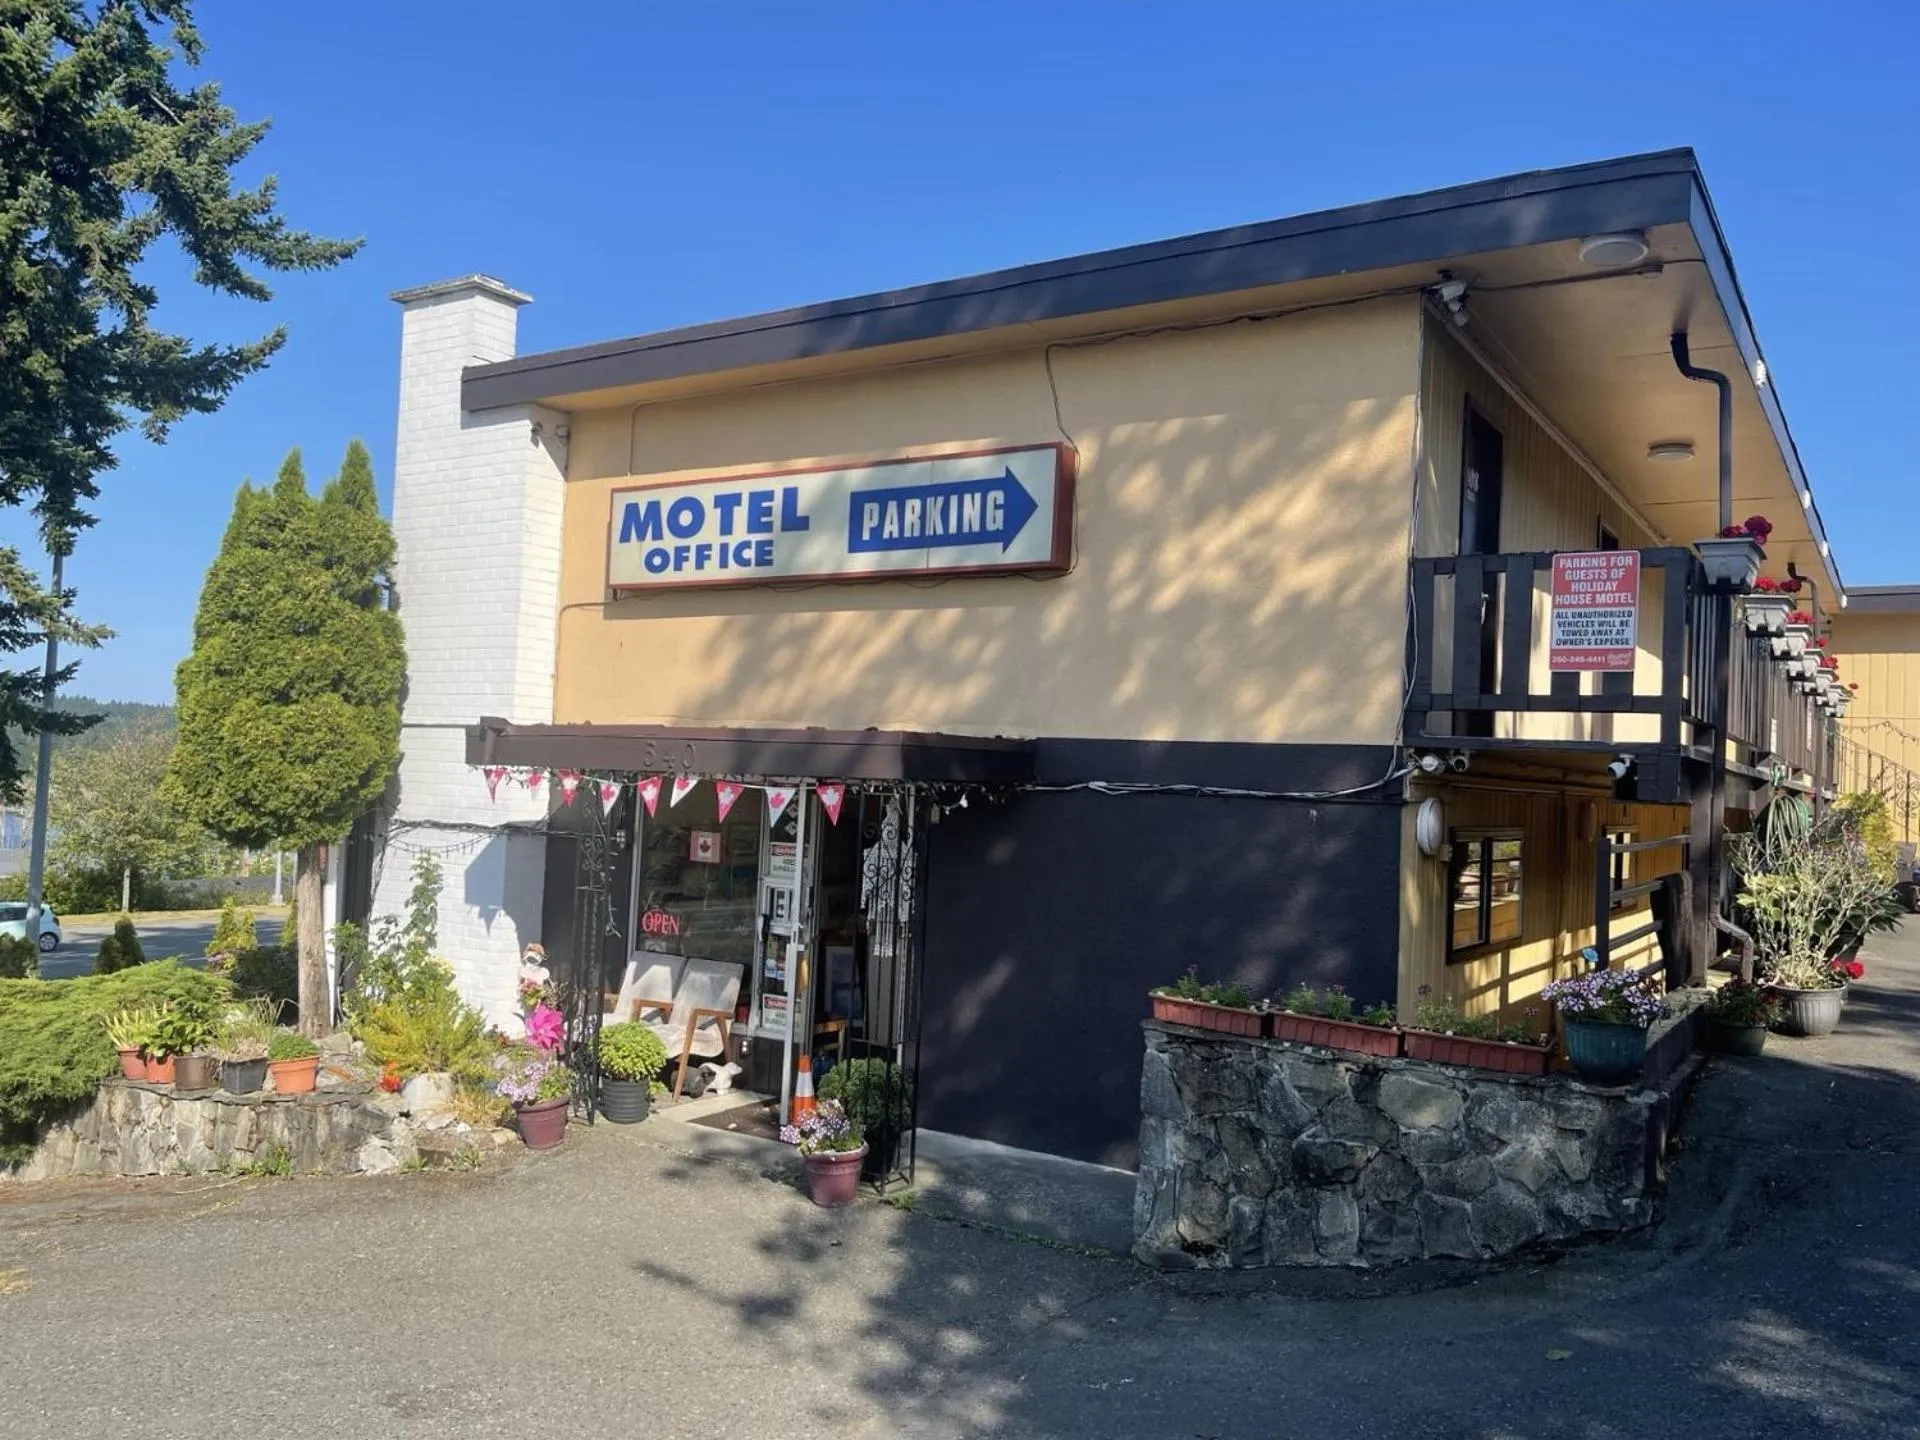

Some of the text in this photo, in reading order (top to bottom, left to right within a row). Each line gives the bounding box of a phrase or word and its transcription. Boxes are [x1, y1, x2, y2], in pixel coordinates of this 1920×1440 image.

[619, 486, 810, 544] MOTEL
[862, 489, 1005, 541] PARKING
[643, 540, 774, 574] OFFICE
[1559, 555, 1633, 568] PARKING FOR
[1565, 567, 1626, 580] GUESTS OF
[1571, 580, 1618, 592] HOLIDAY
[1555, 592, 1634, 605] HOUSE MOTEL
[1555, 610, 1633, 619] ALL UNAUTHORIZED
[1557, 619, 1630, 628] VEHICLES WILL BE
[1561, 628, 1625, 637] TOWED AWAY AT
[1556, 638, 1630, 646] OWNER'S EXPENSE
[642, 911, 680, 936] OPEN
